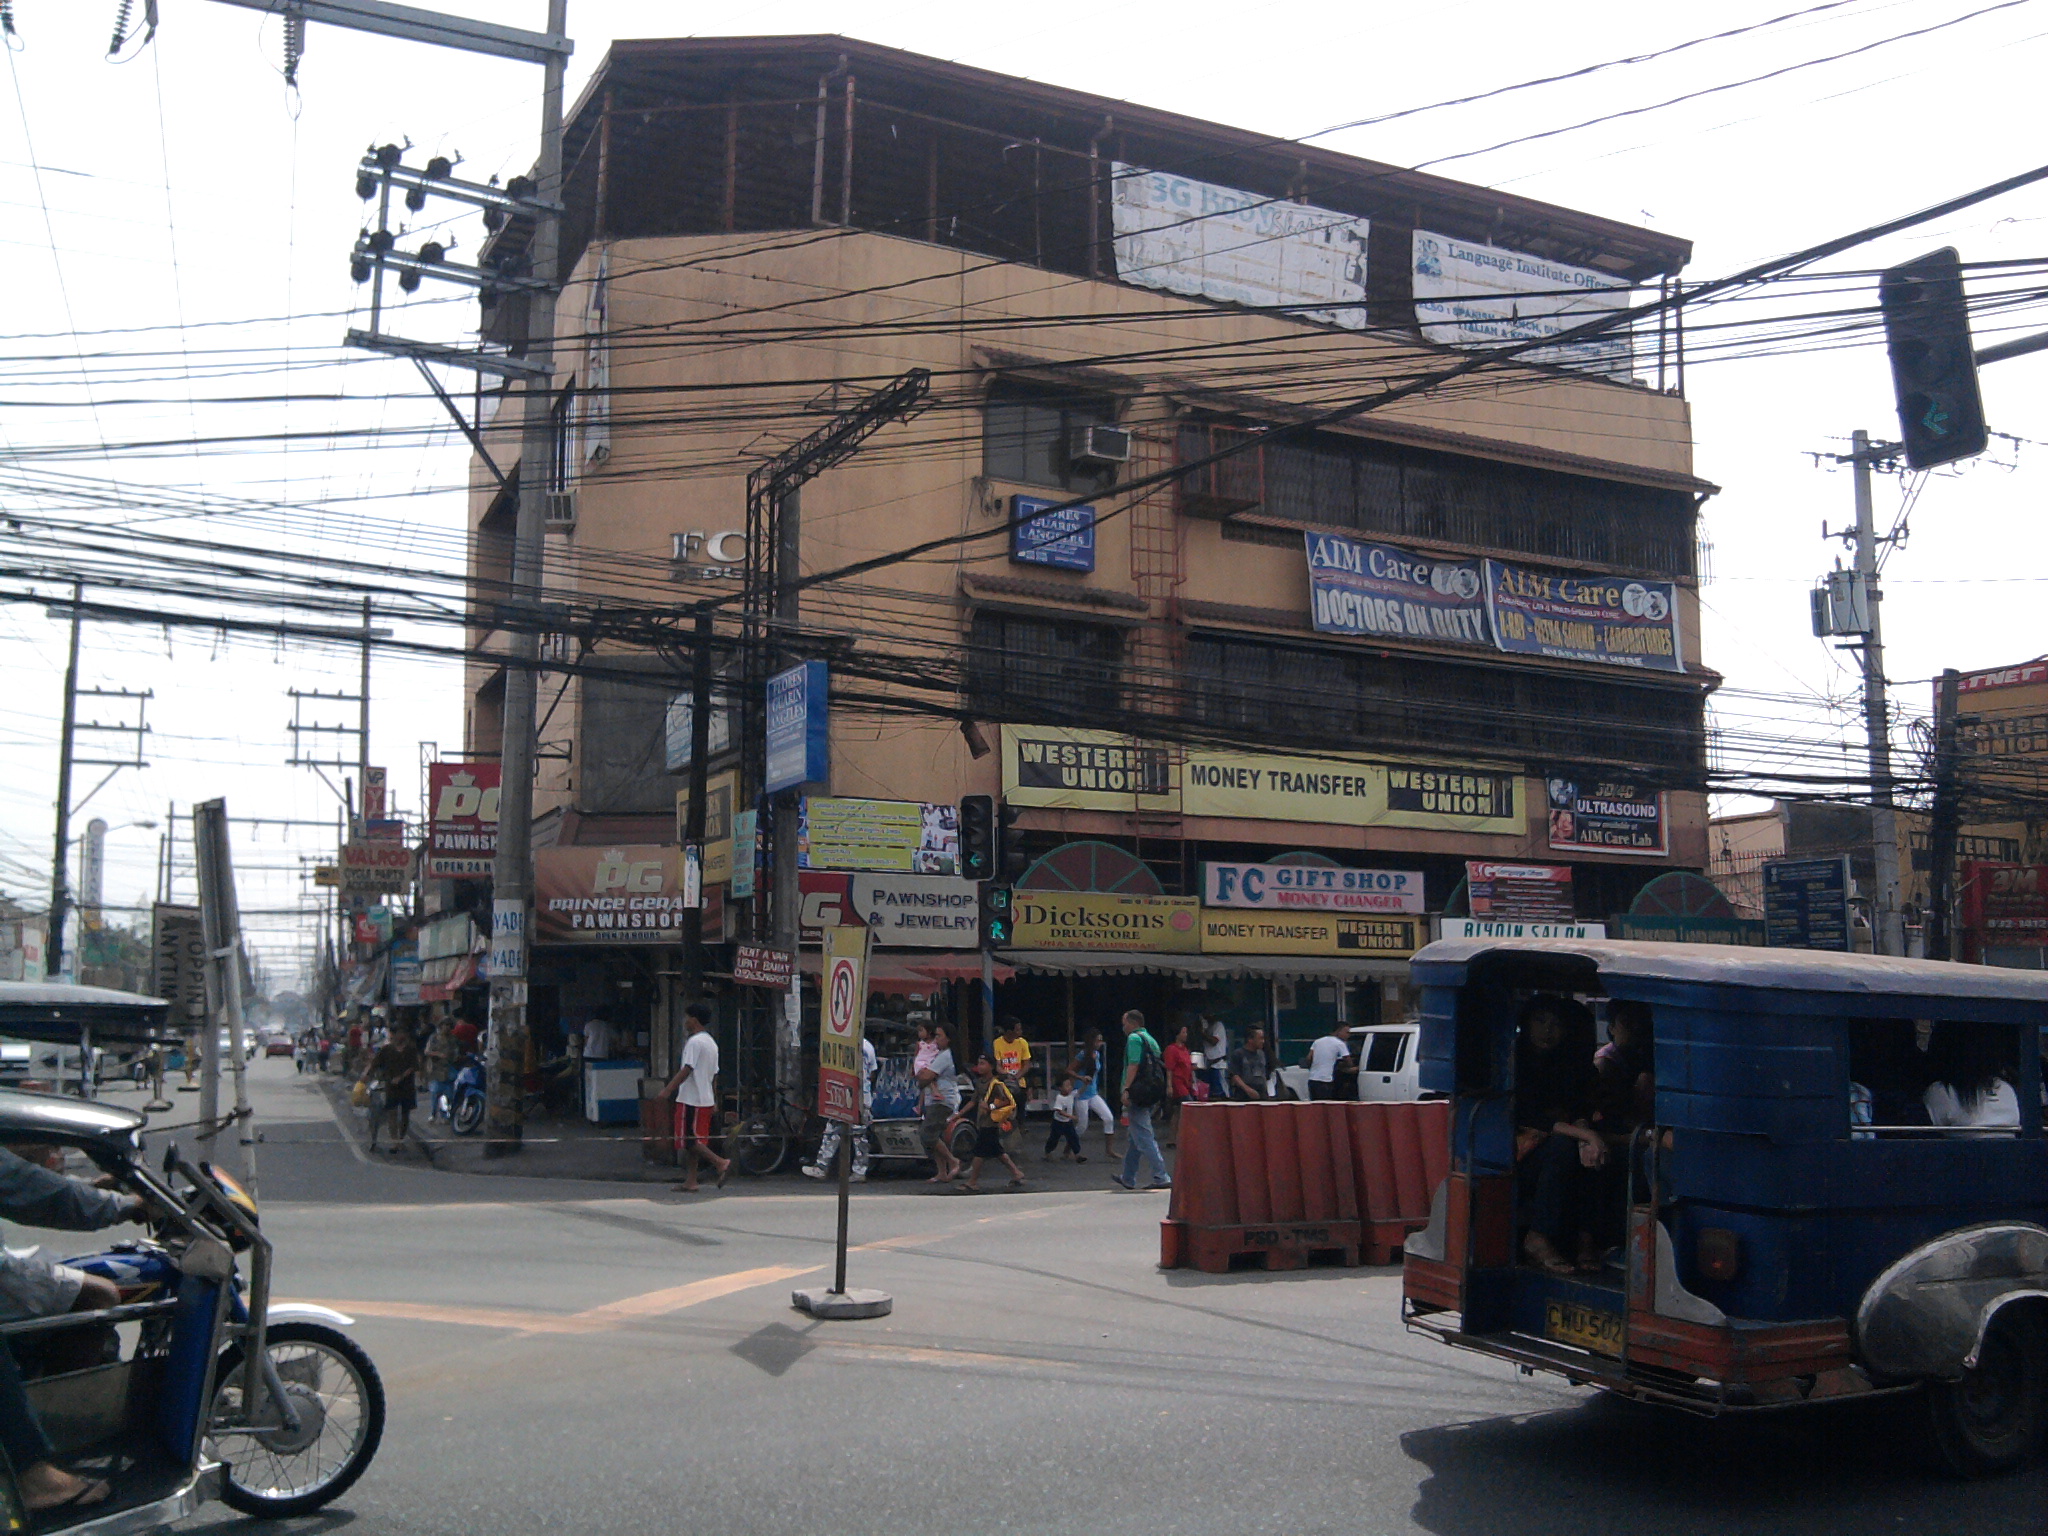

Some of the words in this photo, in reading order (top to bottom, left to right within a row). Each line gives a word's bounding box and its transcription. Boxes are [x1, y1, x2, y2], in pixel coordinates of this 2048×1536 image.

[1448, 243, 1513, 273] Language
[1516, 257, 1571, 284] Institute
[1311, 537, 1363, 574] AIM
[1368, 549, 1429, 585] Care
[1498, 567, 1552, 600] AIM
[1558, 579, 1620, 608] Care
[1316, 588, 1403, 633] DOCTORS
[1403, 602, 1431, 636] ON
[1430, 607, 1485, 641] DUTY
[1022, 743, 1142, 770] WESTERN
[1062, 767, 1142, 791] UNION
[1192, 764, 1261, 791] MONEY
[1268, 770, 1367, 797] TRANSFER
[1390, 770, 1490, 796] WESTERN
[1421, 792, 1490, 815] UNION
[1577, 799, 1656, 818] ULTRASOUND
[435, 833, 498, 850] PAWNSH
[1580, 829, 1602, 843] AIM
[1604, 832, 1629, 845] Care
[1632, 833, 1653, 847] Lab
[594, 861, 663, 893] PG
[1215, 866, 1266, 904] FC
[1277, 869, 1336, 887] GIFT
[1343, 871, 1408, 890] SHOP
[873, 889, 974, 907] PAWNSHOP
[1277, 892, 1331, 906] MONEY
[1333, 893, 1404, 909] CHANGER
[572, 913, 683, 928] PAWNSHOP
[869, 911, 885, 926] &
[895, 912, 977, 930] JEWELRY
[1023, 904, 1165, 930] Dicksons
[1337, 920, 1402, 936] WESTERN
[1050, 928, 1141, 940] DRUGSTORE
[1208, 922, 1254, 938] MONEY
[1258, 924, 1329, 940] TRANSFER
[1358, 934, 1404, 949] UNION
